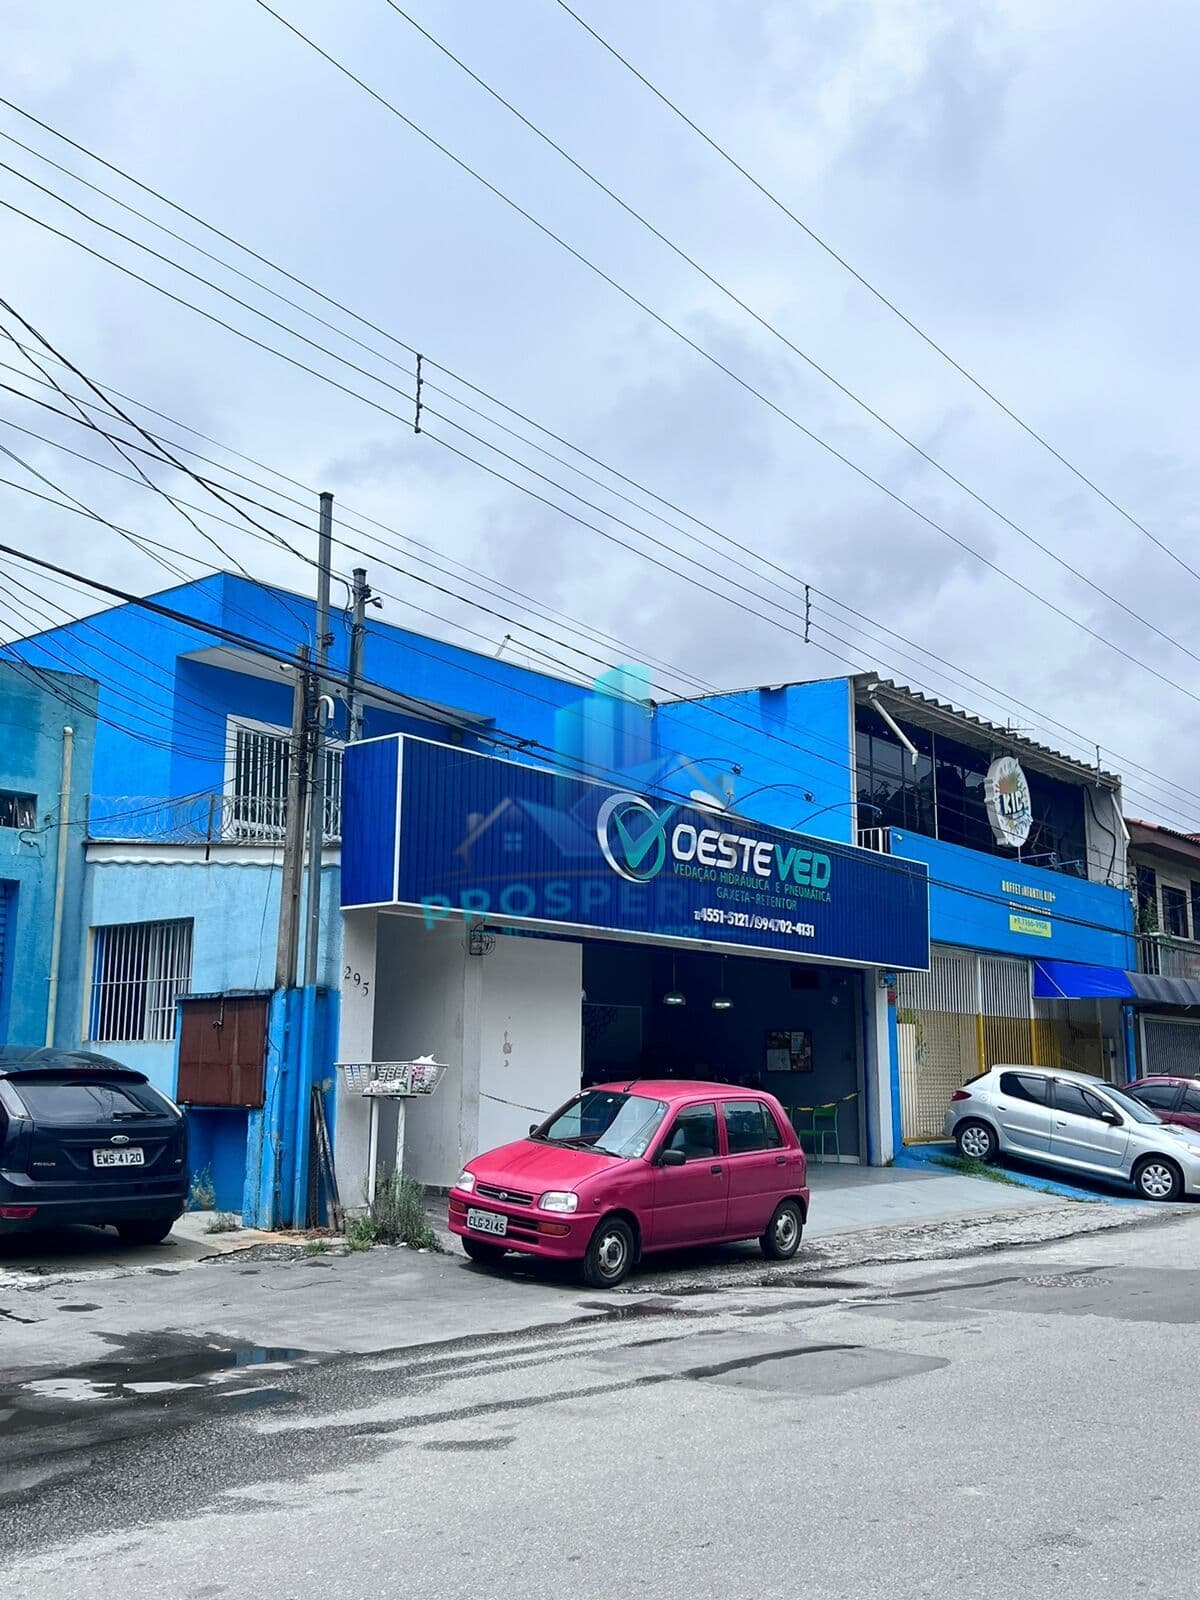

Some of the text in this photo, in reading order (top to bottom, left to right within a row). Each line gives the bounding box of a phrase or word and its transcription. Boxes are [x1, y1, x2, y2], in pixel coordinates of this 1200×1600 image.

[671, 823, 831, 889] OESTEVED
[672, 862, 832, 904] VEDAÇÃO HIDRÁULICA E PNEUMÁTICA
[344, 965, 370, 998] 295
